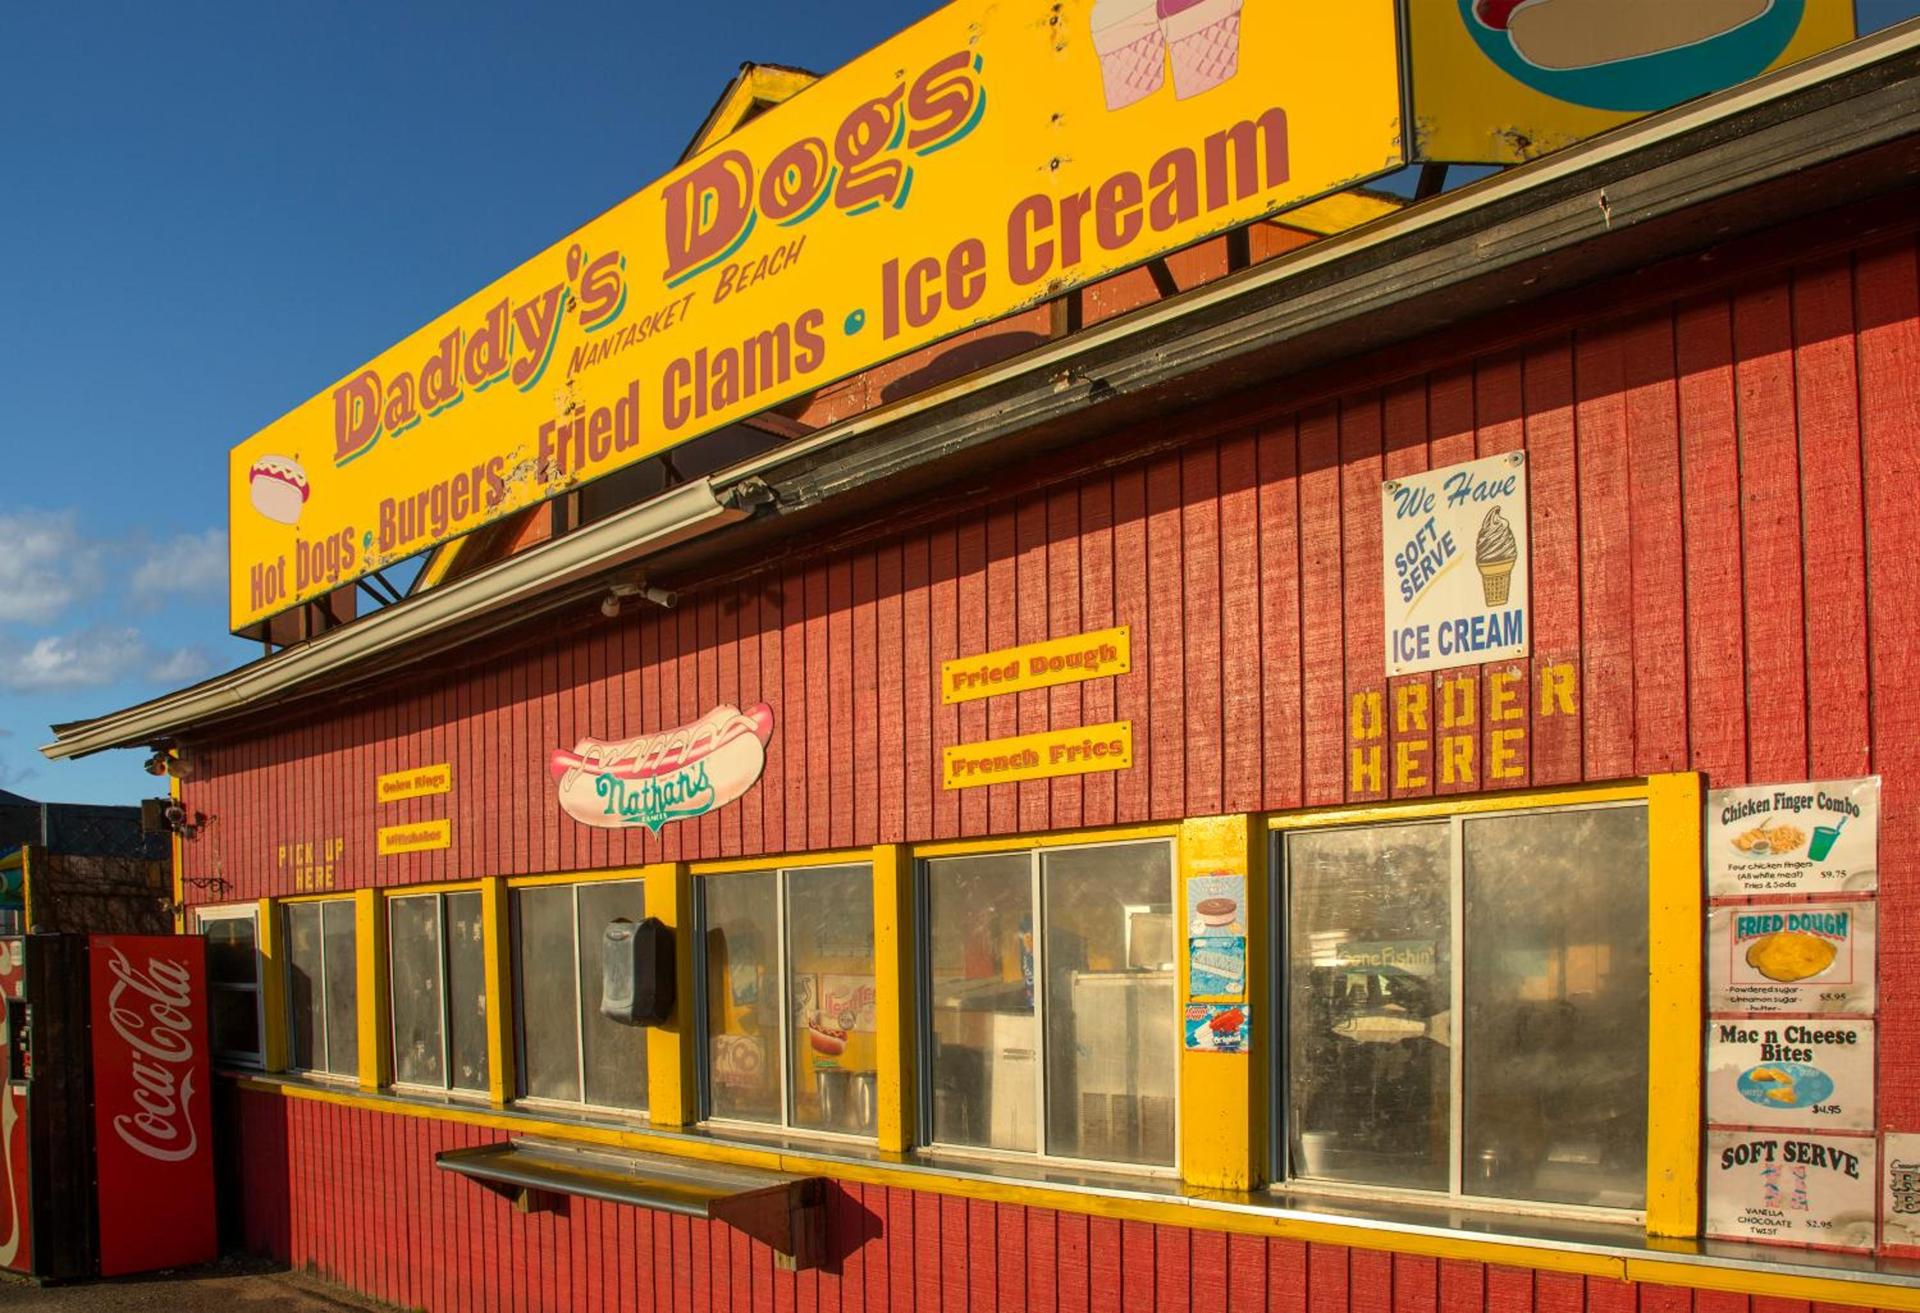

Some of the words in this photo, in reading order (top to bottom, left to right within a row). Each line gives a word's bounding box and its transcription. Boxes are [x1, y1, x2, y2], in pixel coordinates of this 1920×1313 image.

[333, 244, 627, 467] Daddy's
[661, 51, 985, 288] Dogs
[567, 293, 695, 377] NANTASKET
[713, 235, 806, 304] BEACH
[251, 549, 286, 612] Hot
[296, 526, 356, 589] Dogs
[379, 455, 505, 552] Burgers
[538, 380, 640, 484] Fried
[662, 308, 825, 431] Clams
[882, 237, 987, 341] Ice
[1007, 107, 1290, 286] Cream
[1394, 486, 1435, 519] We
[1443, 471, 1517, 508] Have
[1394, 516, 1440, 577] SOFT
[1400, 529, 1457, 603] SERVE
[1393, 624, 1431, 663] ICE
[1438, 608, 1523, 656] CREAM
[952, 660, 1020, 692] Fried
[1029, 643, 1118, 676] Dough
[1352, 663, 1577, 740] ORDER
[951, 748, 1040, 778] French
[1049, 739, 1124, 764] Fries
[1352, 728, 1525, 793] HERE
[415, 773, 445, 790] Rings
[595, 760, 713, 816] Nathan's
[1721, 798, 1770, 825] Chicken
[1773, 792, 1814, 814] Finger
[1817, 791, 1860, 818] Combo
[279, 842, 314, 868] PICK
[325, 838, 344, 862] UP
[1748, 862, 1782, 870] chicken
[295, 865, 334, 889] HERE
[1819, 870, 1847, 879] $9.75
[1736, 913, 1784, 941] FRIED
[1786, 912, 1848, 938] DOUGH
[108, 944, 198, 1162] Coca-Cola
[1720, 1025, 1760, 1044] Mac
[1764, 1031, 1779, 1044] n
[1784, 1025, 1857, 1044] Cheese
[1760, 1044, 1813, 1062] Bites
[1811, 1105, 1842, 1114] $4.95
[1721, 1140, 1779, 1170] SOFT
[1783, 1141, 1860, 1180] SERVE
[1738, 1216, 1792, 1228] CHOCOLATE
[1745, 1207, 1784, 1217] VANILLA
[1750, 1227, 1778, 1235] TWIST
